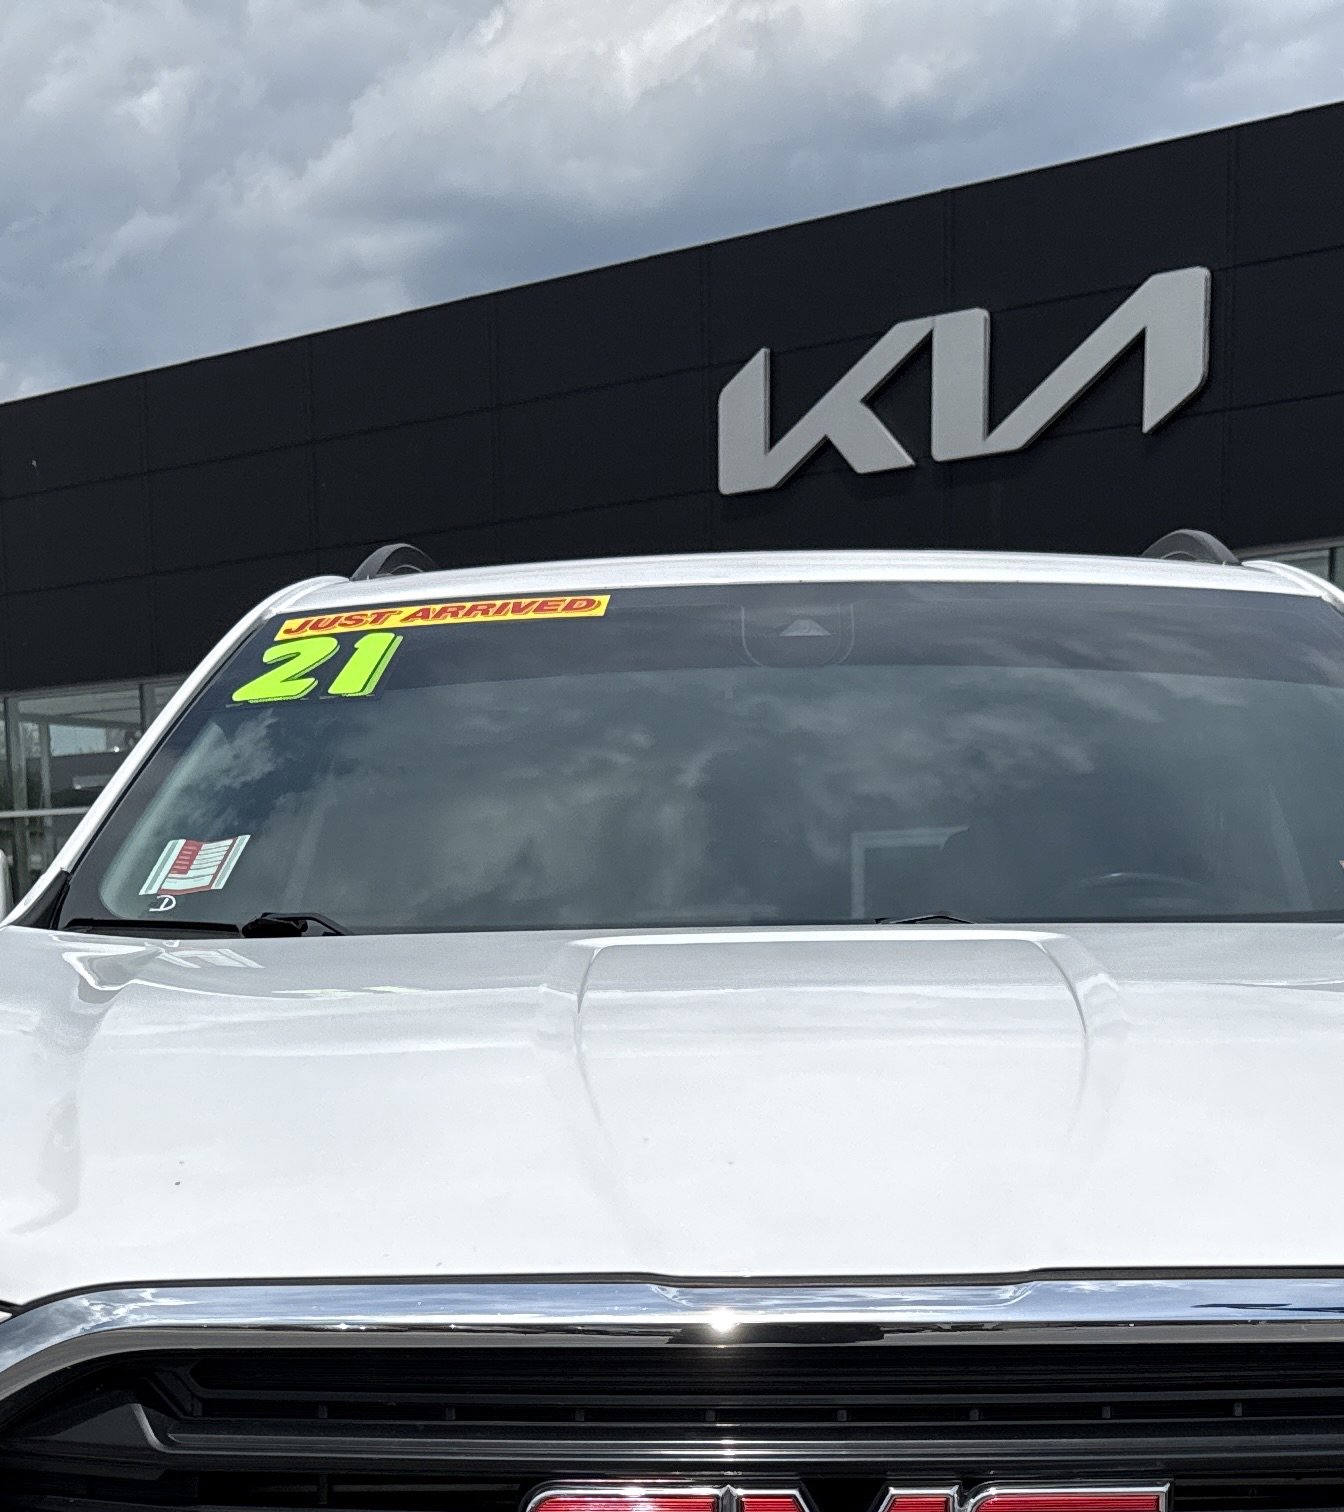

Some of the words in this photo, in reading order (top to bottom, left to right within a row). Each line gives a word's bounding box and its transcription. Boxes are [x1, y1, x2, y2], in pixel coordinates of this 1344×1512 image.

[283, 610, 398, 635] JUST
[405, 598, 601, 623] ARRIVED
[232, 632, 404, 704] 21
